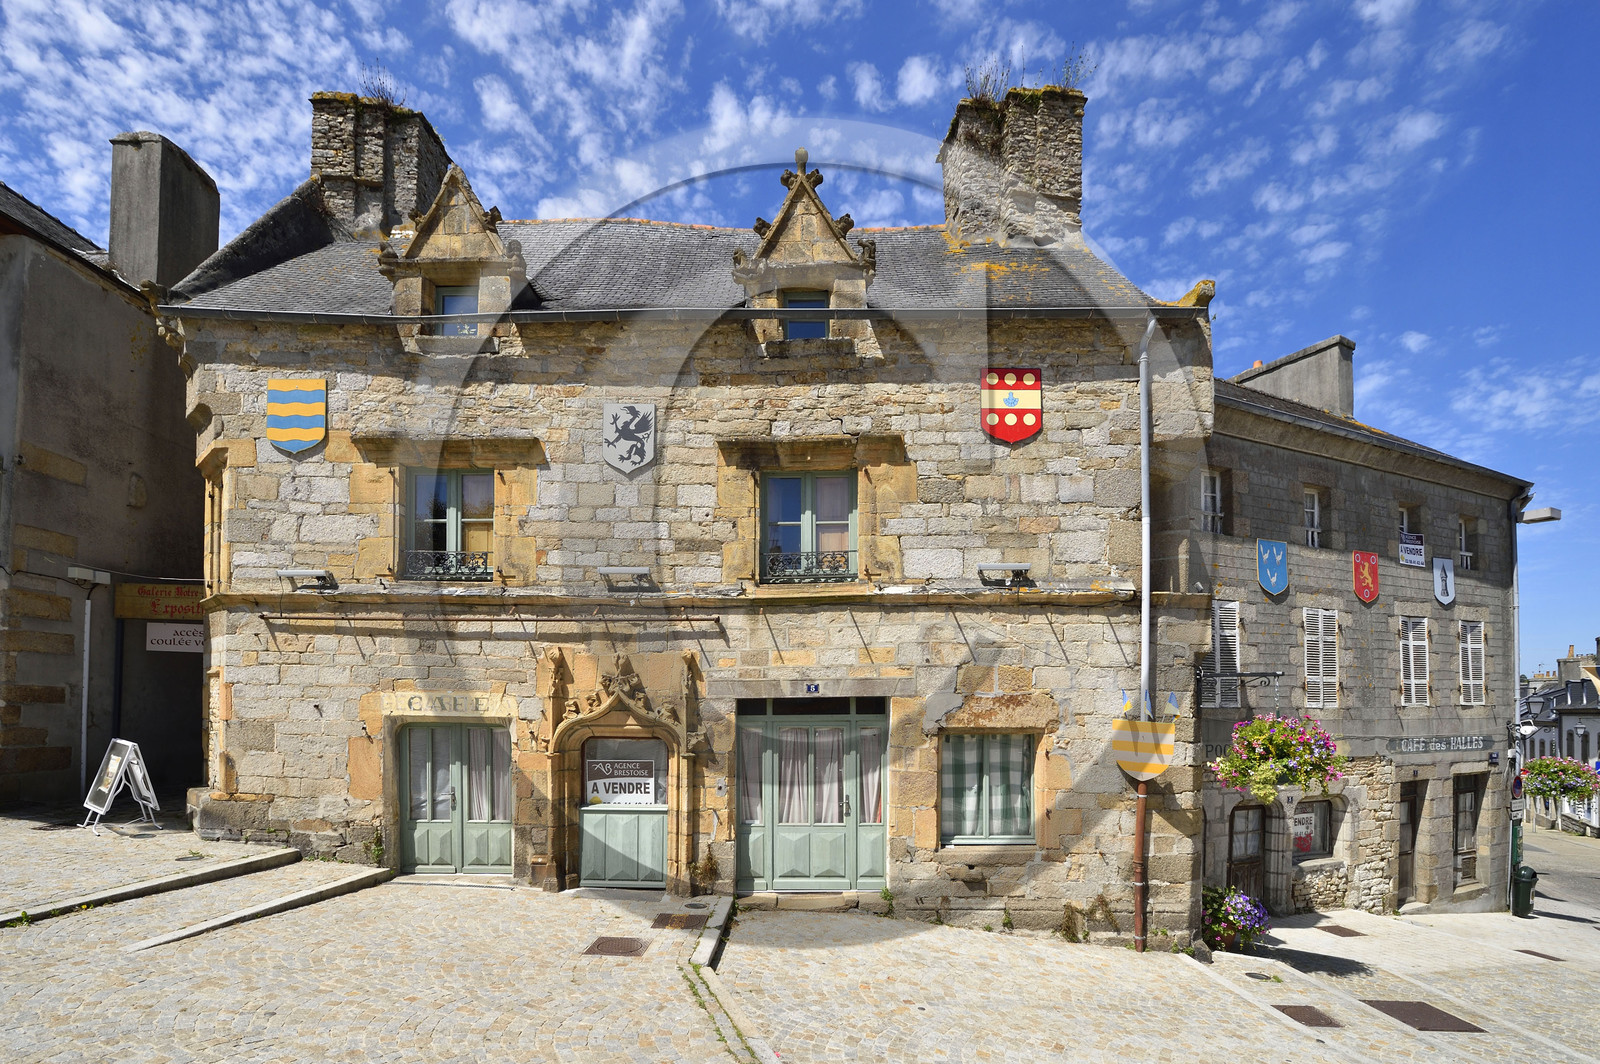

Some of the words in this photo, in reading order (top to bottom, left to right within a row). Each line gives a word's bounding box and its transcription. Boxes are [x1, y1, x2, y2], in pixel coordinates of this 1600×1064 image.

[1400, 545, 1404, 553] A
[1404, 546, 1423, 557] VENDRE
[137, 585, 172, 597] Galerie
[1429, 738, 1447, 751] des
[1450, 736, 1484, 750] HALLES
[591, 782, 600, 794] A
[603, 782, 650, 794] VENDRE
